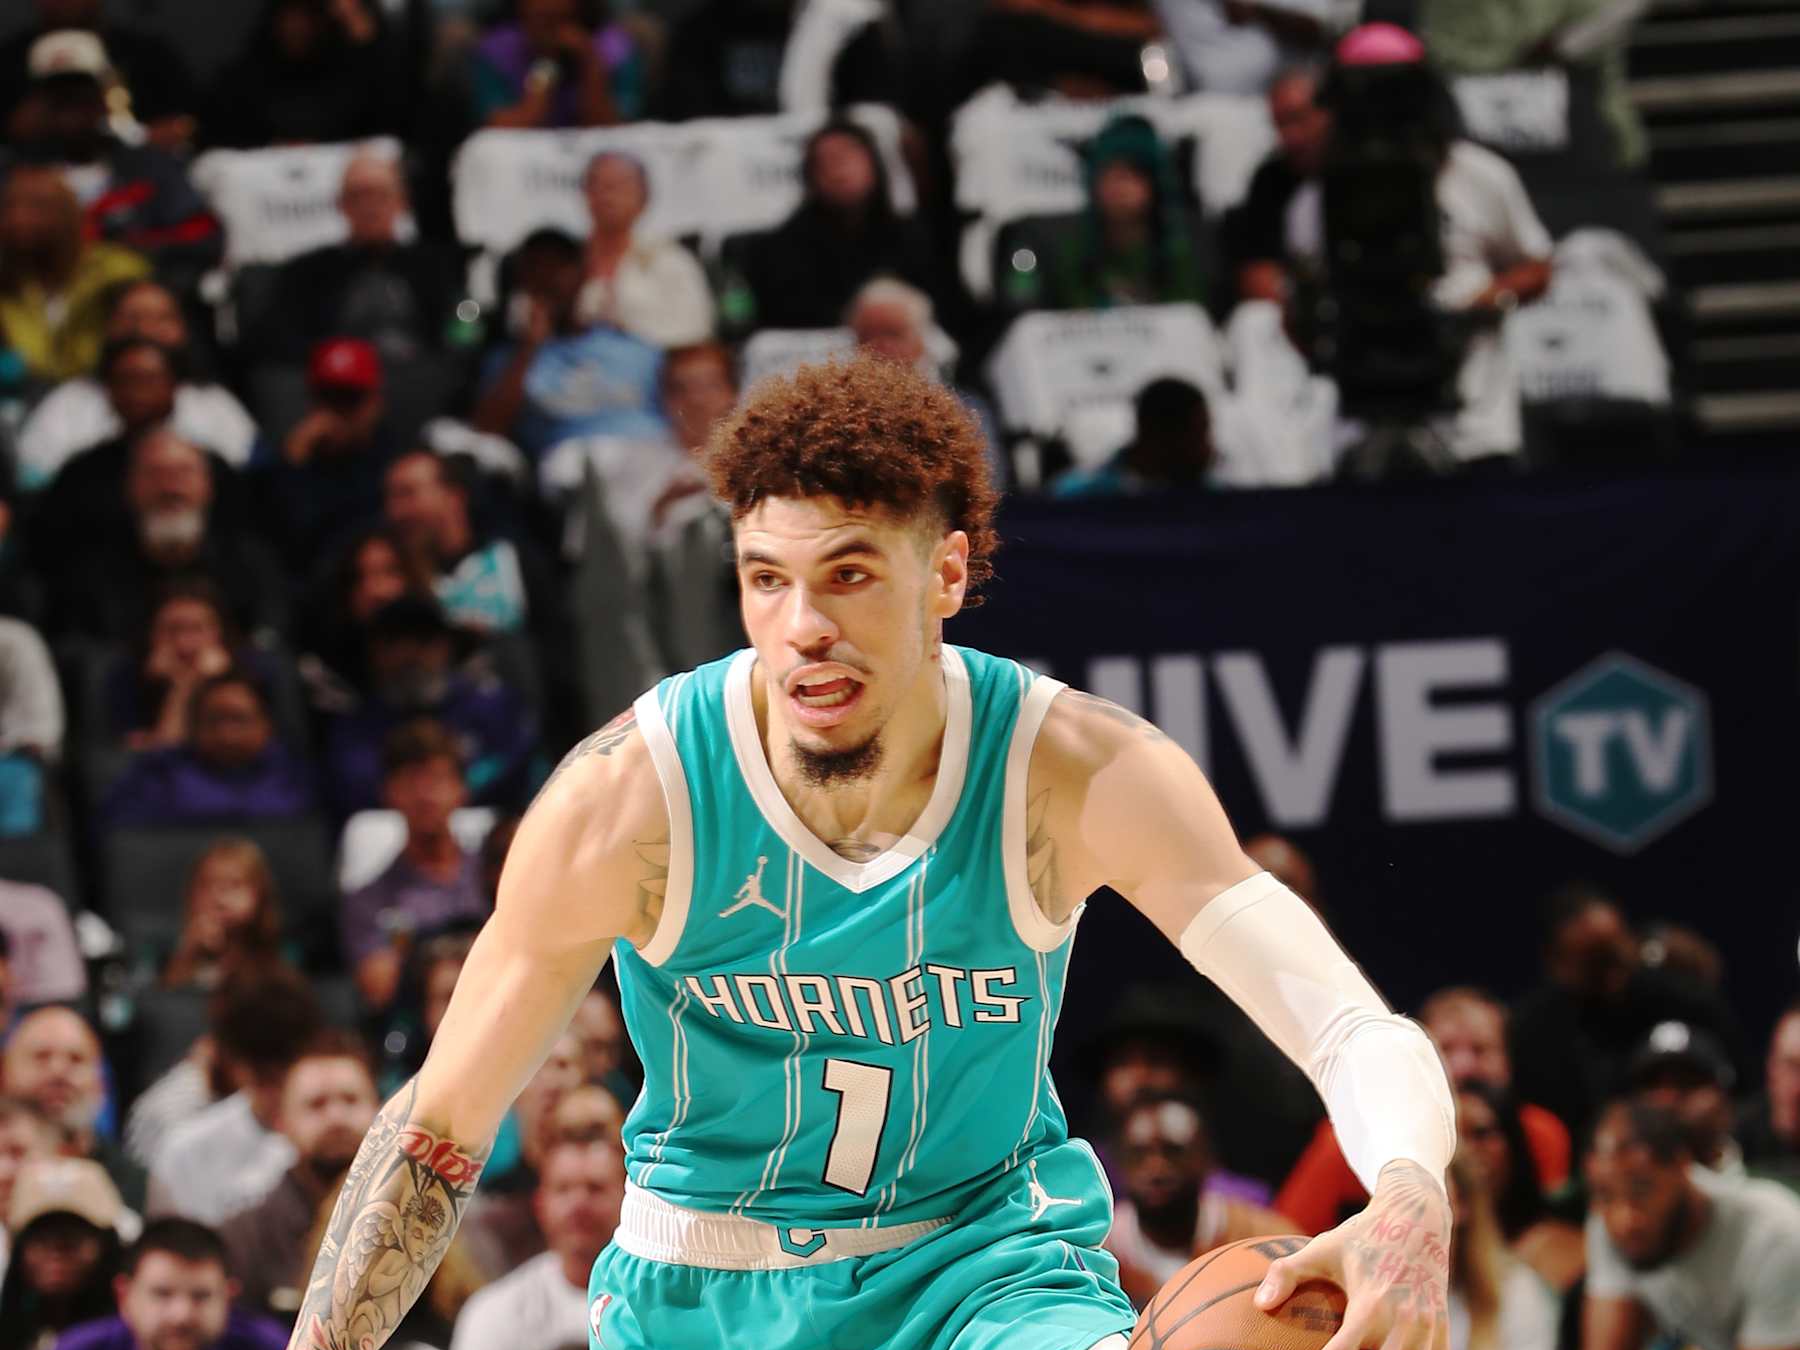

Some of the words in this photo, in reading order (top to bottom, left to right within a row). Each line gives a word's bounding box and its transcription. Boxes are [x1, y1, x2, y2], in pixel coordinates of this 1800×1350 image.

[1036, 639, 1517, 826] IVE
[1556, 708, 1688, 798] TV
[683, 964, 1032, 1046] HORNETS
[821, 1058, 894, 1198] 1
